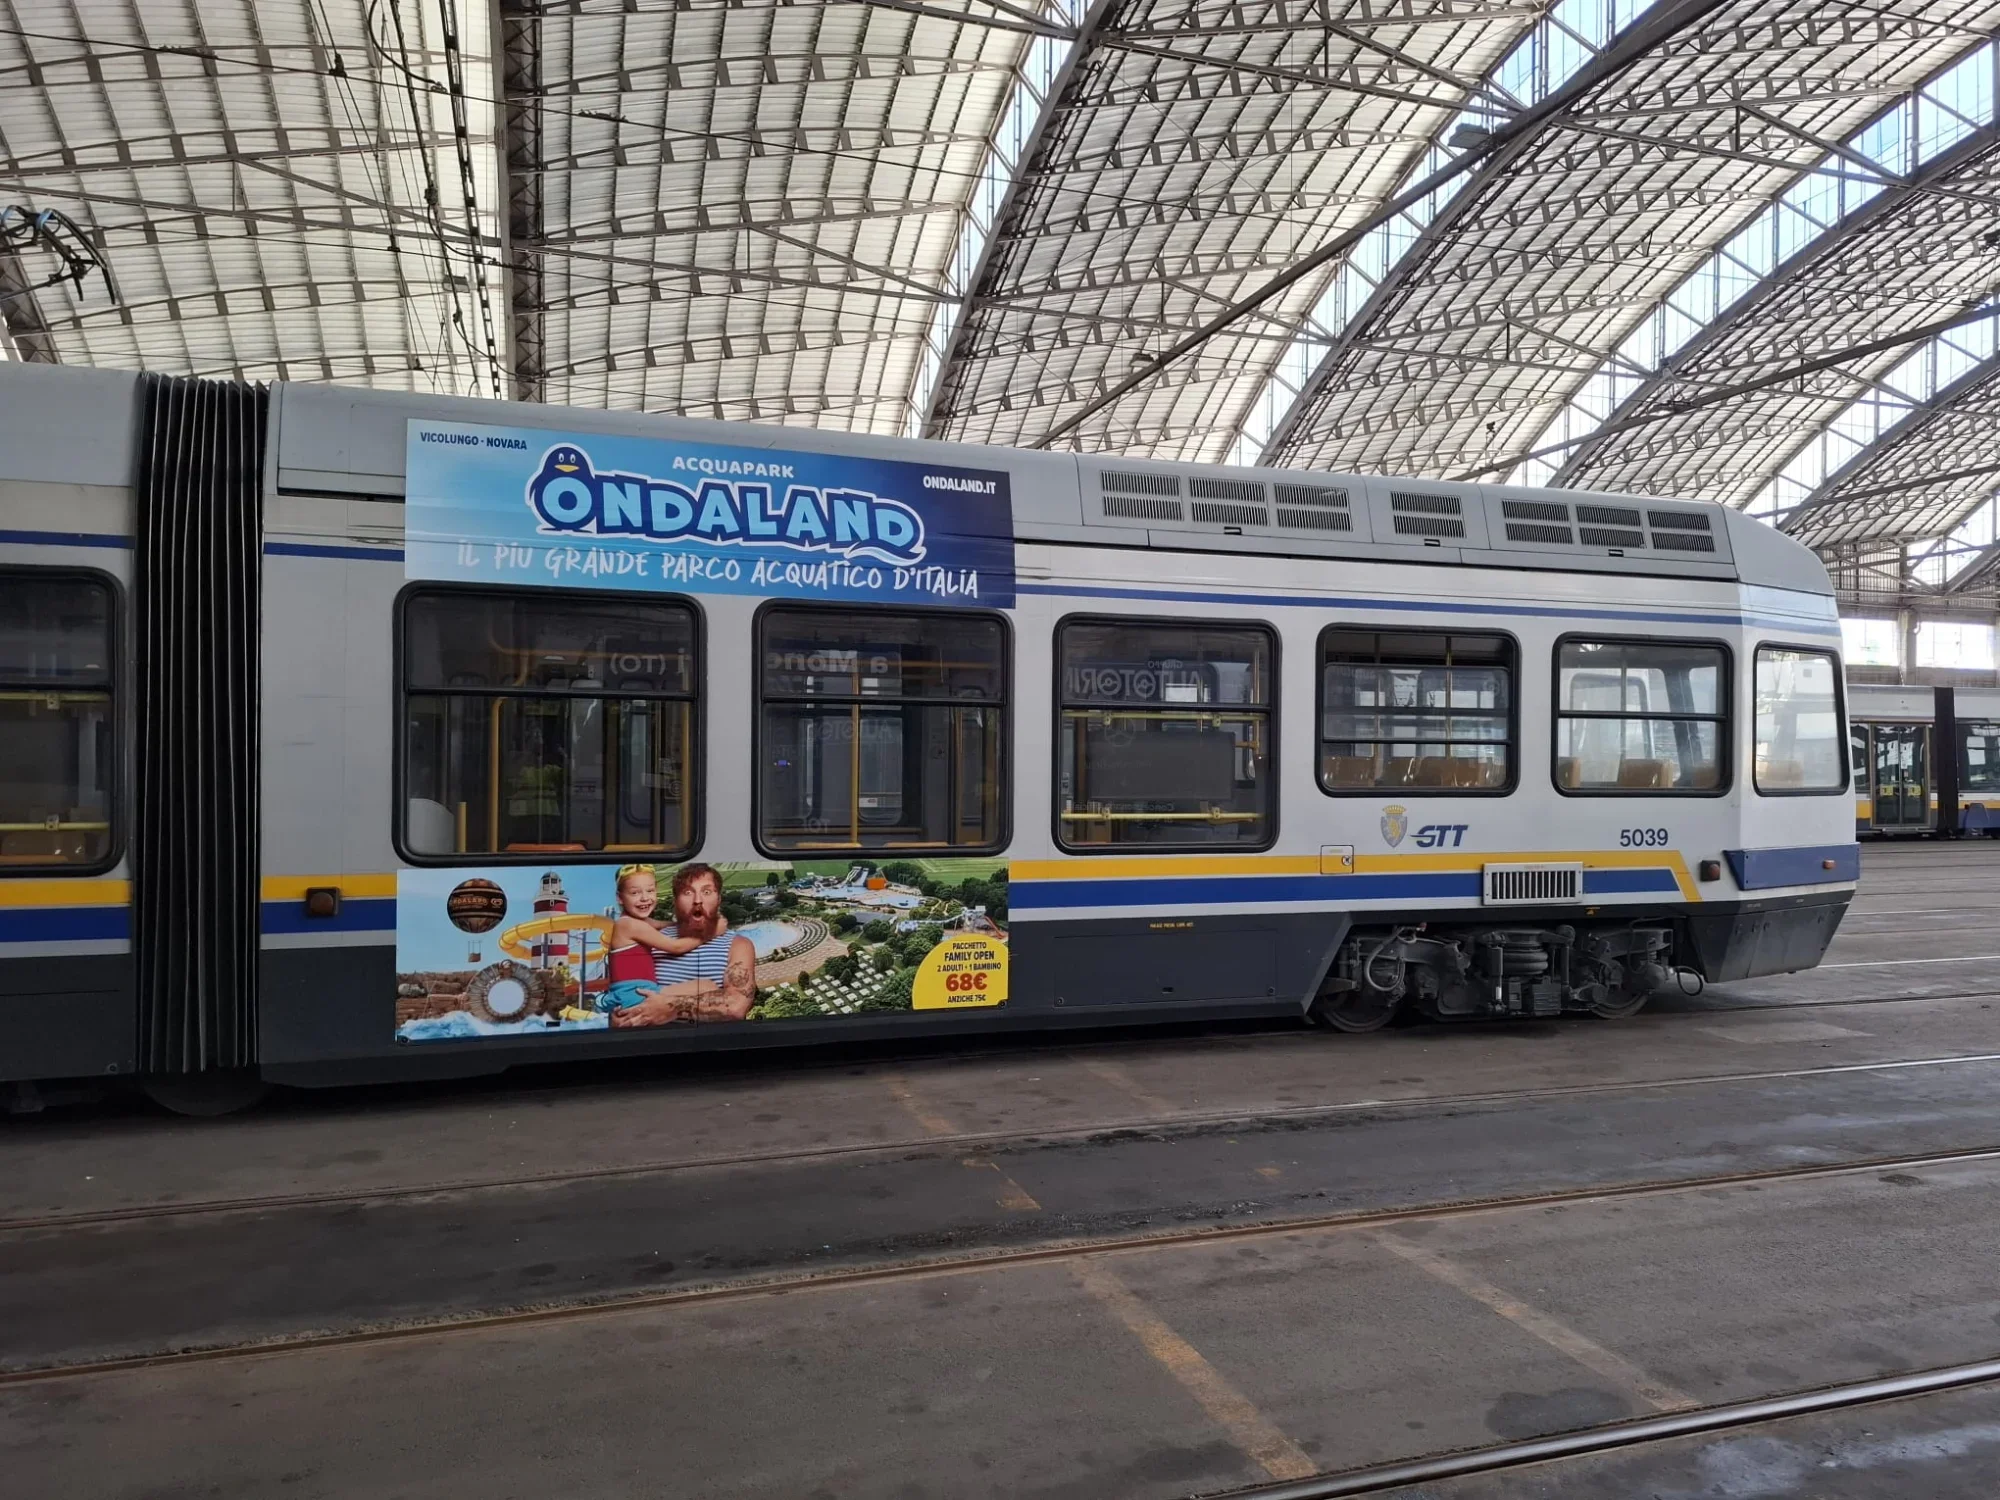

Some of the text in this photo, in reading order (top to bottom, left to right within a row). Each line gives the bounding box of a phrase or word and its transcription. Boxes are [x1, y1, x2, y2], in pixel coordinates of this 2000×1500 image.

[420, 432, 479, 446] VICOLUNGO
[486, 436, 528, 450] NOVARA
[672, 456, 793, 478] ACQUAPARK
[923, 474, 996, 494] ONDALAND.IT
[540, 474, 916, 544] ONDALAND
[457, 539, 480, 568] IL
[544, 546, 650, 579] GRANDE
[661, 552, 741, 583] PARCO
[751, 557, 882, 590] ACQUATICO
[894, 566, 979, 599] D'ITALIA
[1410, 824, 1469, 848] STT
[1619, 828, 1669, 847] 5039
[952, 941, 986, 950] PACCHETTO
[944, 951, 994, 961] FAMILY OPEN
[942, 964, 963, 972] ADULTI
[973, 962, 1001, 970] BAMBINO
[945, 972, 987, 991] 68€
[947, 994, 974, 1003] ANZICHE
